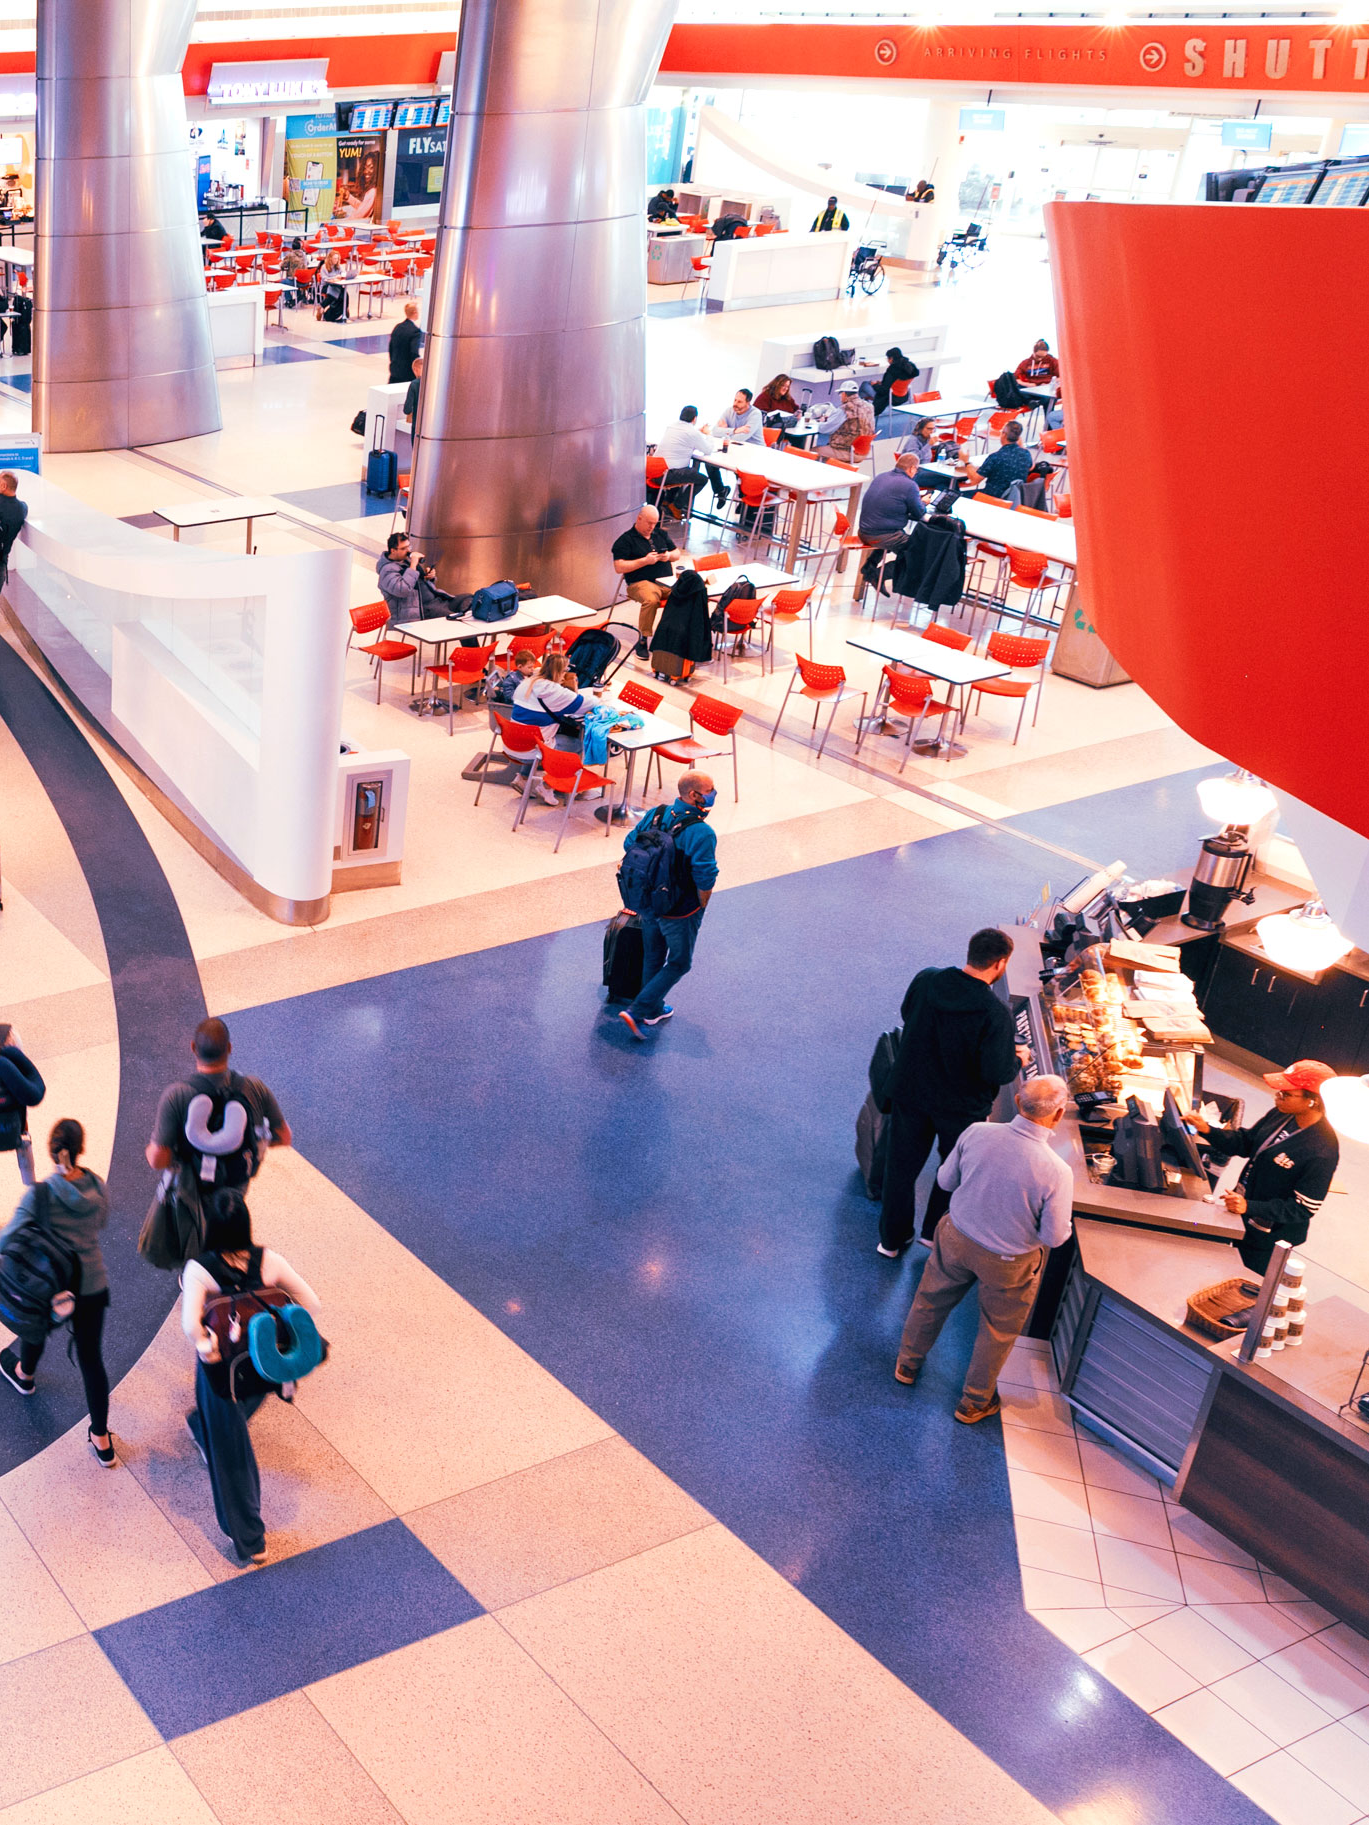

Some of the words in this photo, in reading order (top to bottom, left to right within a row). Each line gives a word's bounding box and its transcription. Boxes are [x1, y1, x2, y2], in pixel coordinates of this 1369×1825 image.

[924, 47, 1011, 59] ARRIVING
[1025, 48, 1107, 61] FLIGHTS
[1183, 38, 1369, 80] SHUTT
[339, 147, 363, 158] YUM!
